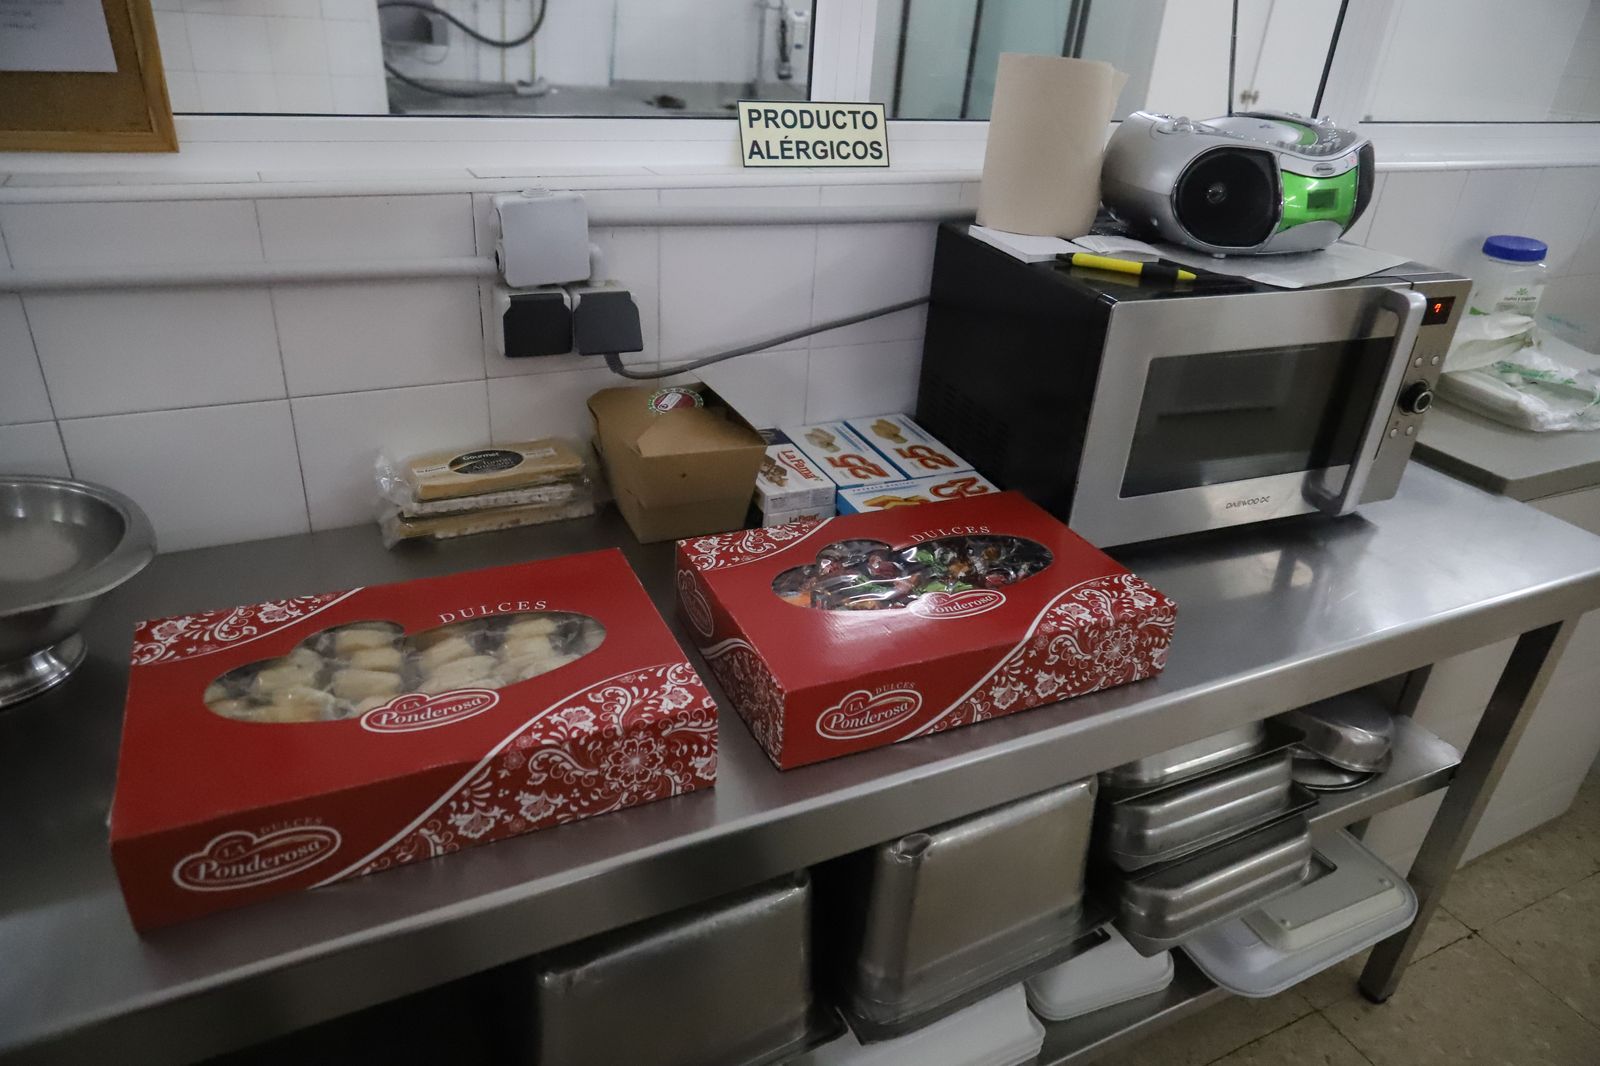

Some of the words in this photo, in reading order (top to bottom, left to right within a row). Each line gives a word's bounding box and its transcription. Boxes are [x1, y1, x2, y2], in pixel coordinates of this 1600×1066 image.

[747, 108, 878, 130] PRODUCTO
[748, 135, 883, 160] ALÉRGICOS
[462, 452, 499, 461] Gourmet
[911, 525, 991, 542] DULCES
[439, 600, 547, 624] DULCES
[924, 595, 993, 614] onderosa
[875, 681, 916, 694] DULCES
[380, 697, 482, 726] Ponderosa
[402, 701, 420, 710] LA
[849, 701, 864, 712] LA
[830, 702, 909, 729] Ponderosa
[260, 817, 323, 834] DULCES
[222, 844, 246, 858] LA
[198, 840, 320, 881] Ponderosa
